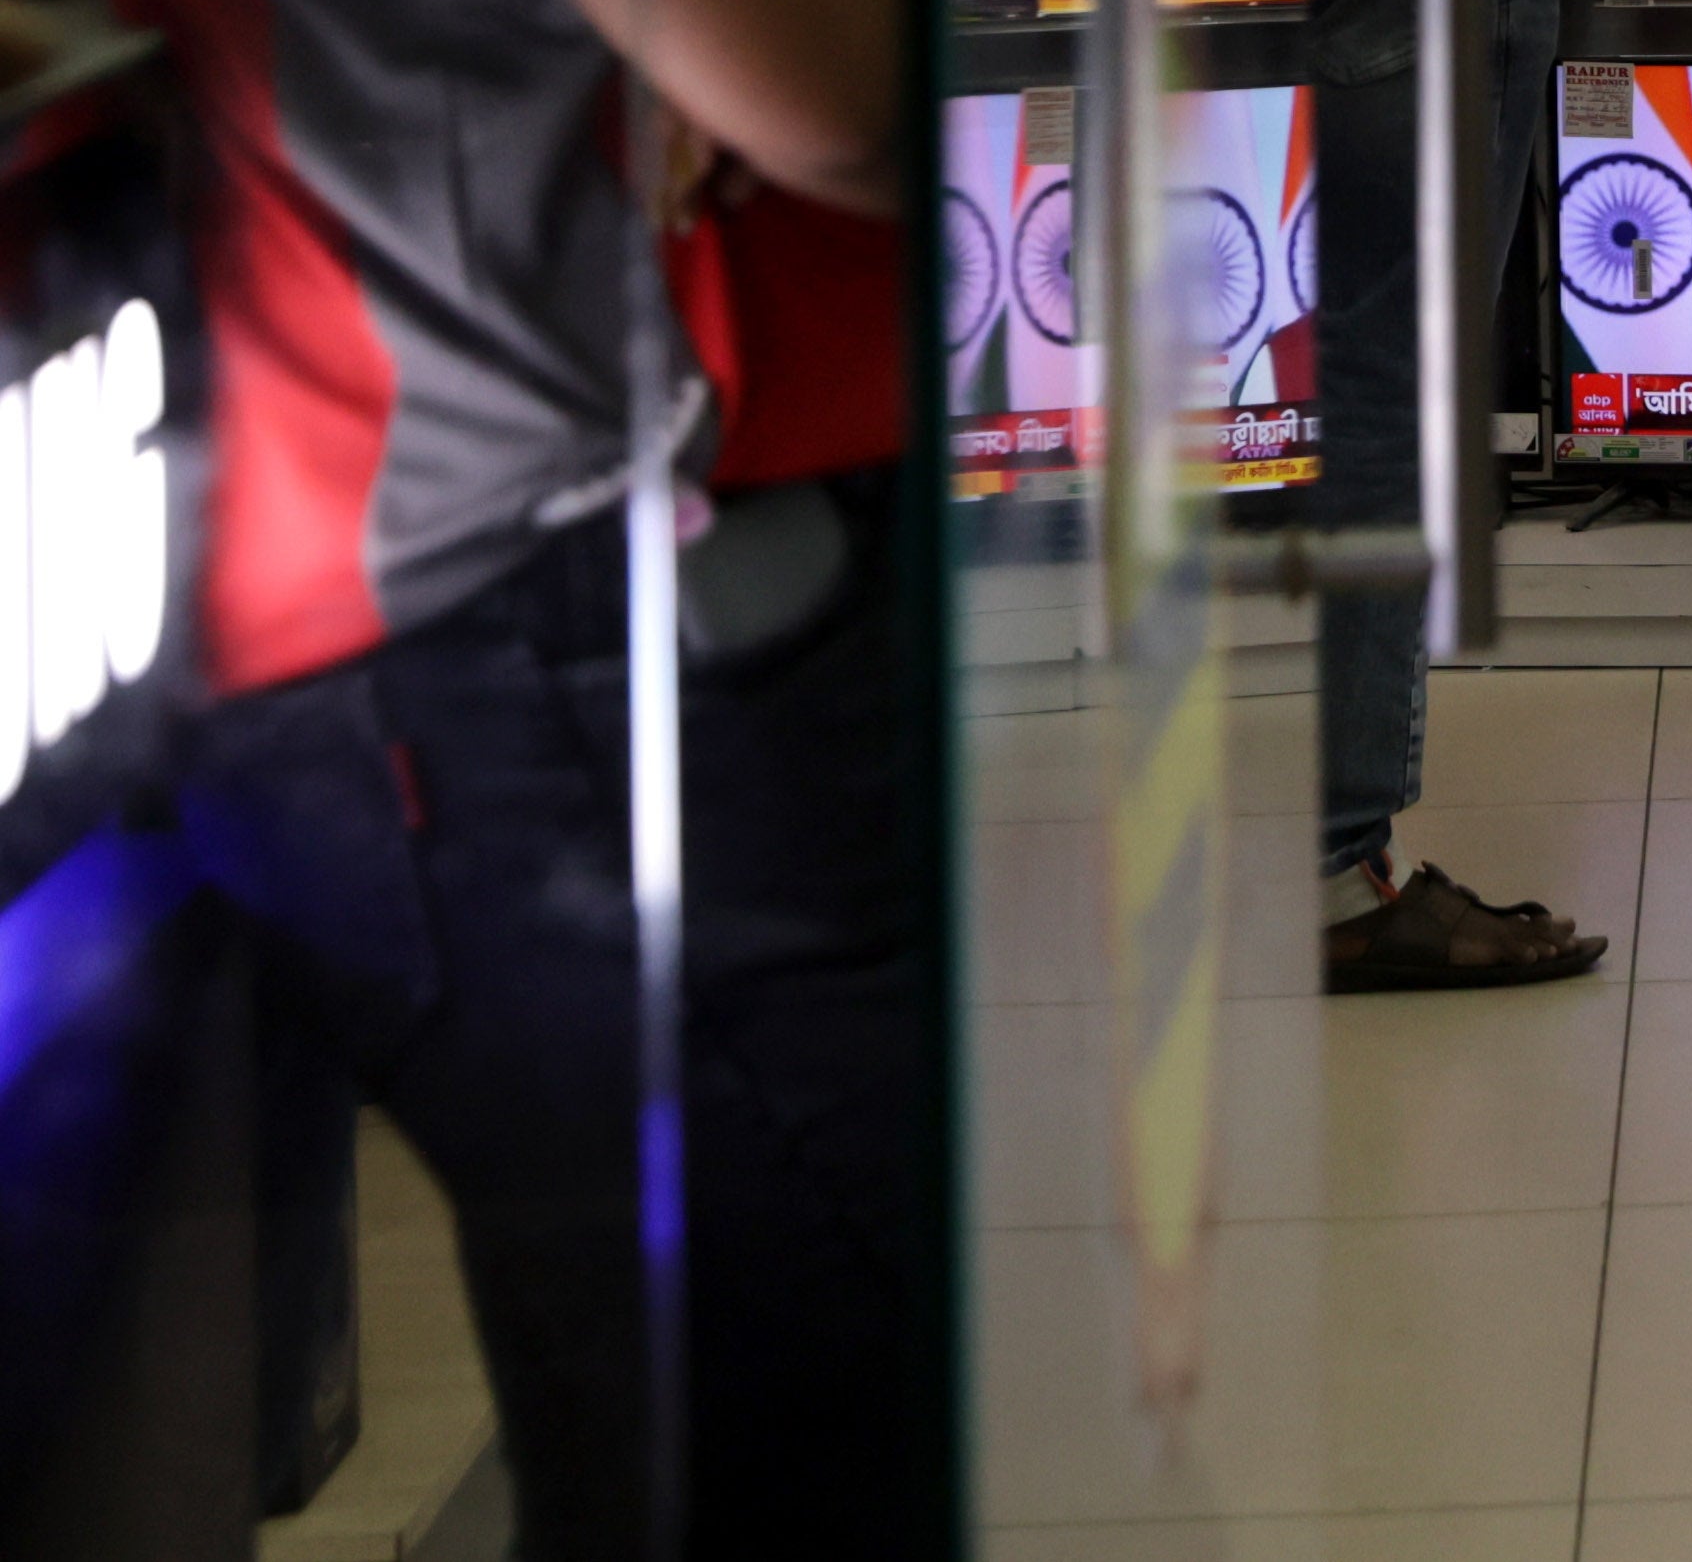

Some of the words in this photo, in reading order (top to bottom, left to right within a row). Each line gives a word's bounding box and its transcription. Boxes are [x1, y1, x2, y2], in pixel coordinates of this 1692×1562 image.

[1566, 65, 1629, 78] RAIPUR
[1566, 78, 1630, 86] ELECTRONICS
[1583, 394, 1611, 408] abp
